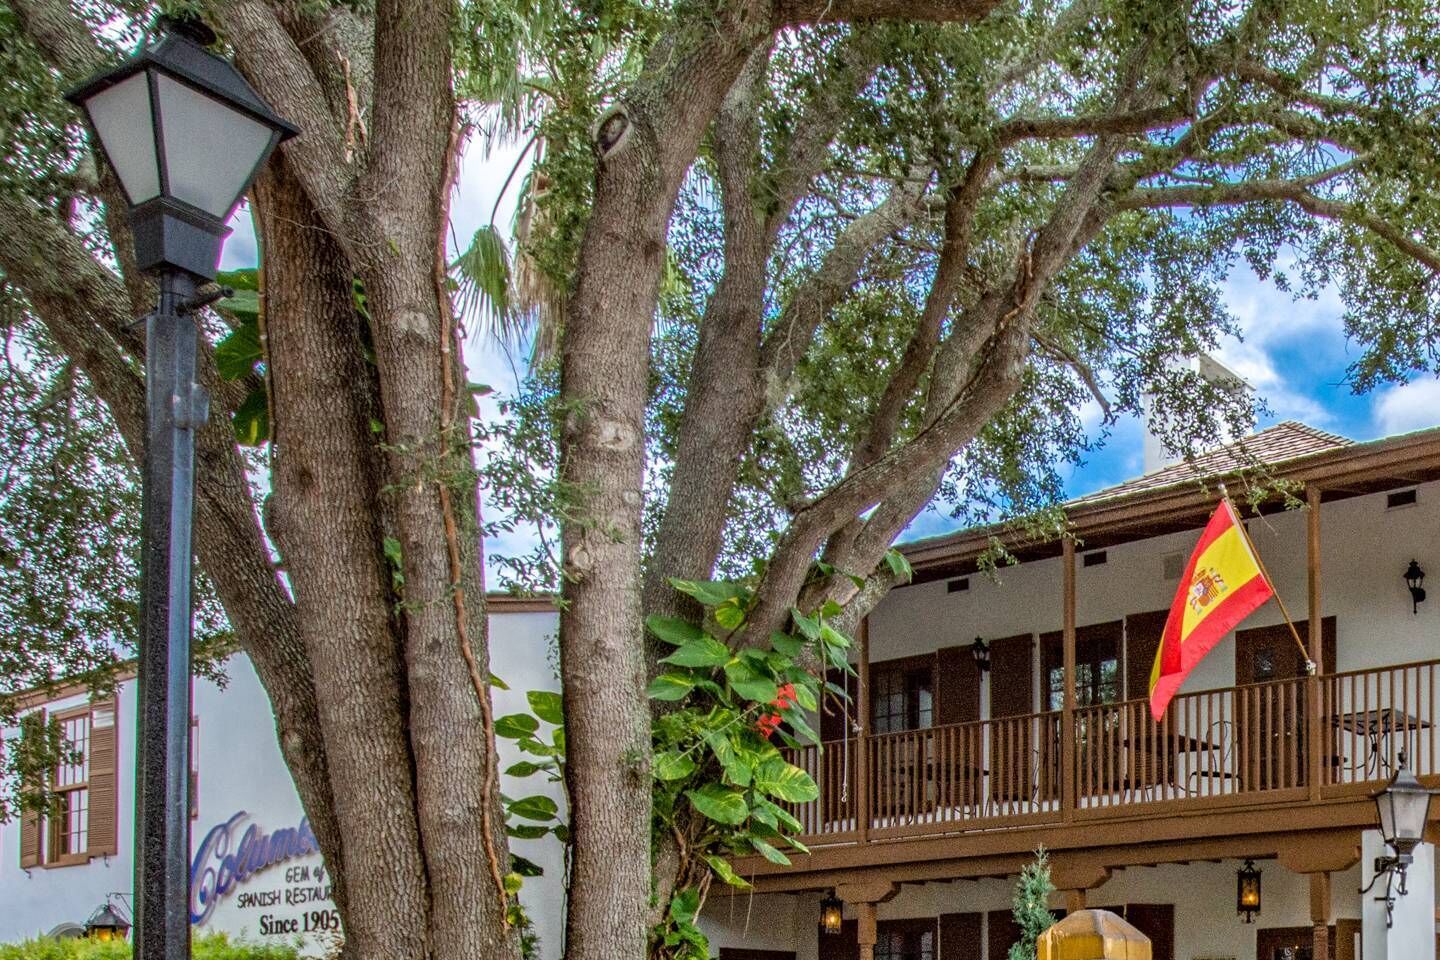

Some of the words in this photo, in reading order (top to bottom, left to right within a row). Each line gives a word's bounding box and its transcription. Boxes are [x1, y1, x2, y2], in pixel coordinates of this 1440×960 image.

[285, 866, 310, 884] GEM
[237, 889, 281, 909] SPANISH
[259, 914, 298, 936] Since
[303, 909, 340, 934] 1905
